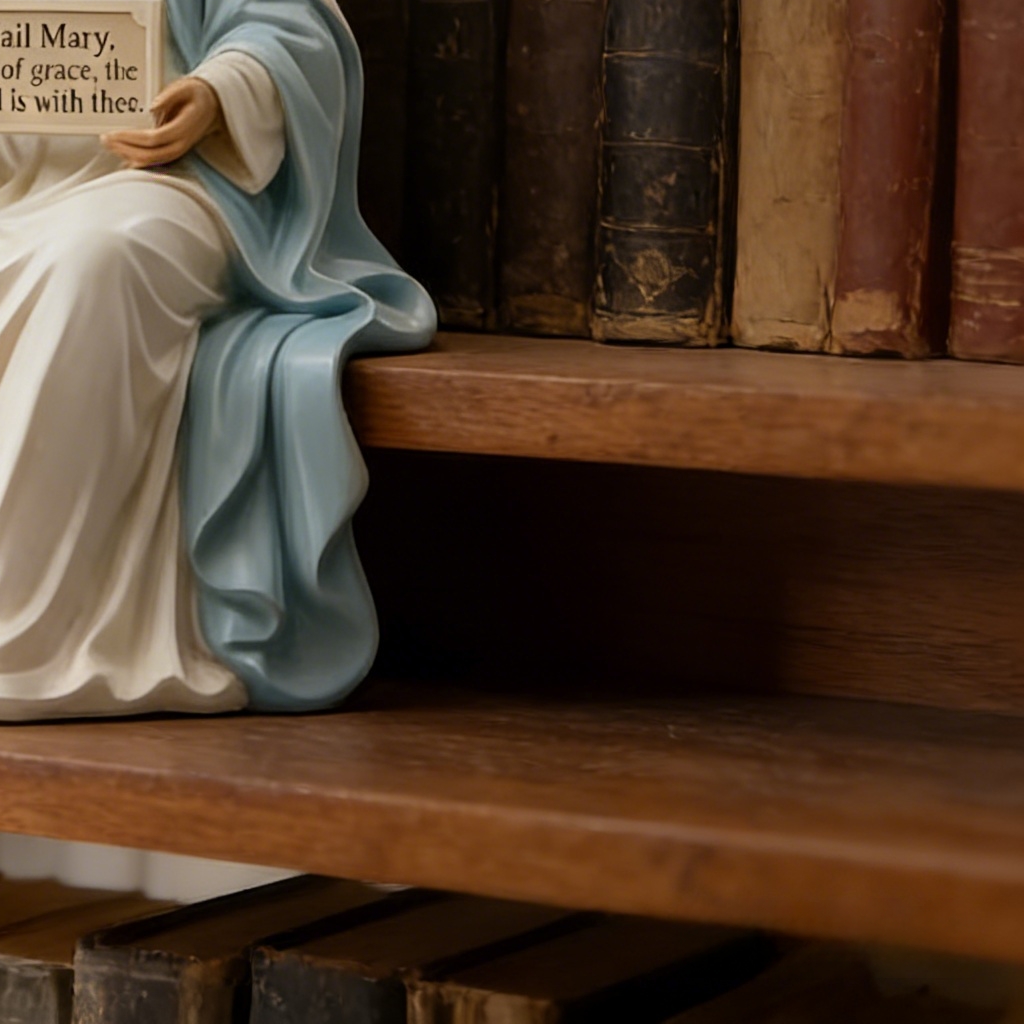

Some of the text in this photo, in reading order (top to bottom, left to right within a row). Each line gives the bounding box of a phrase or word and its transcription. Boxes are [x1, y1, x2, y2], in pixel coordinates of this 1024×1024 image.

[41, 23, 115, 57] Mary,
[1, 57, 25, 80] of
[30, 63, 99, 86] grace,
[105, 58, 138, 81] the
[11, 88, 27, 112] is
[34, 89, 83, 113] with
